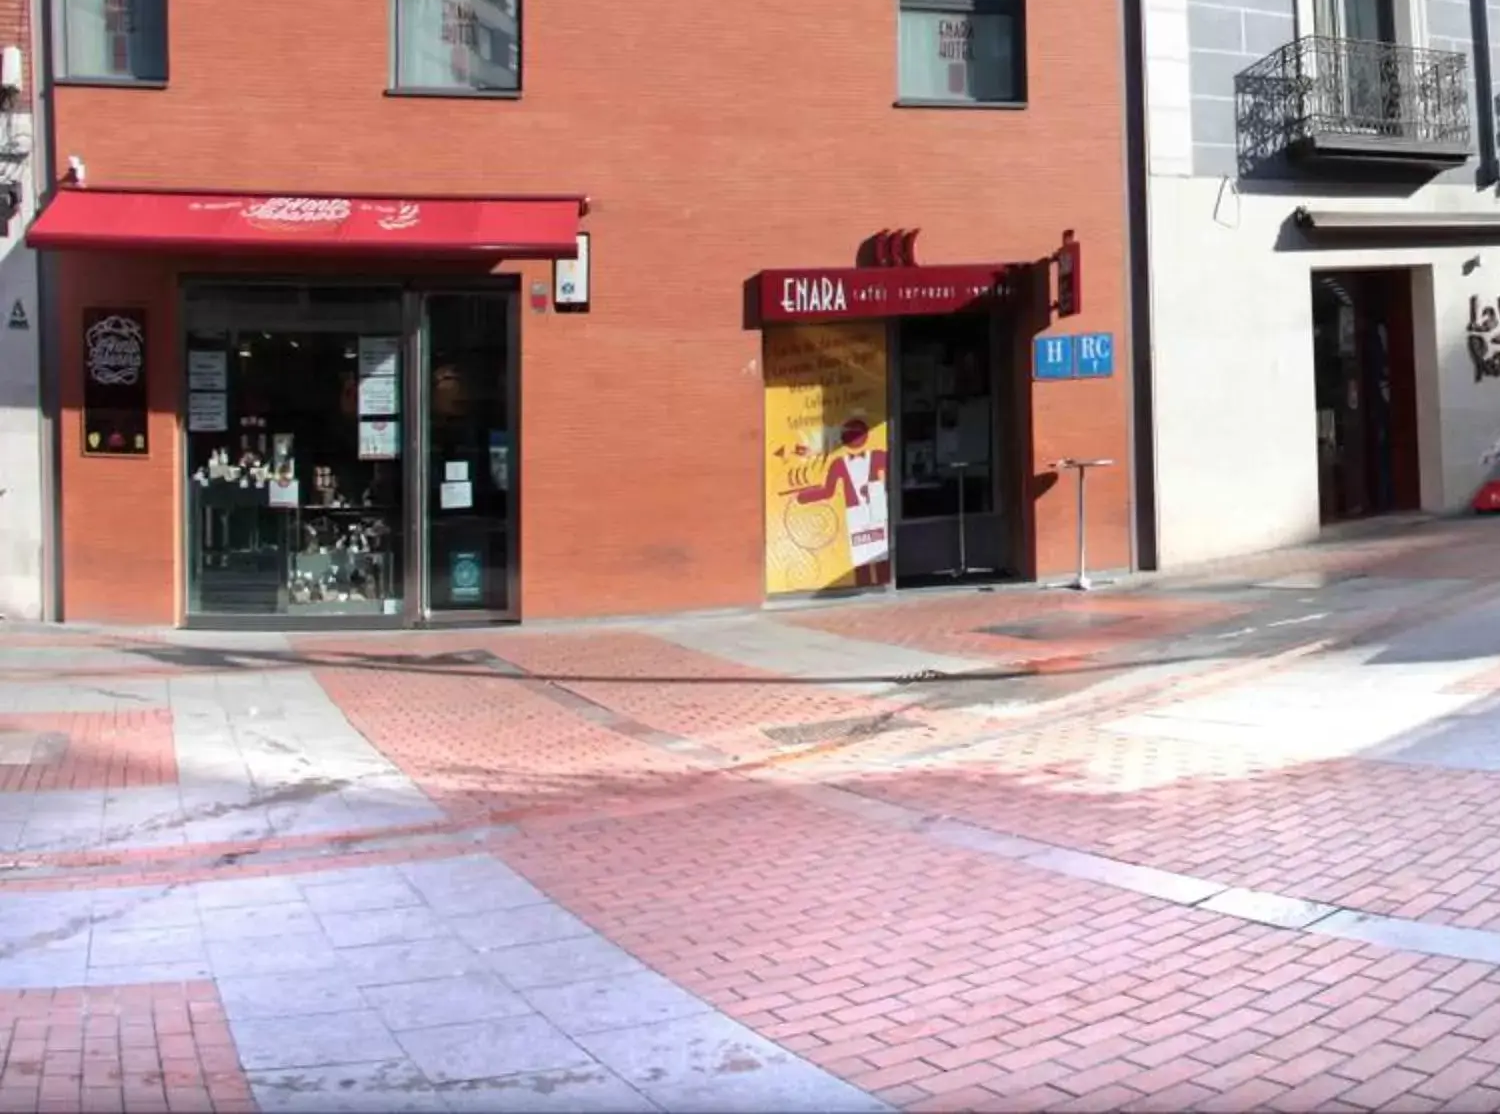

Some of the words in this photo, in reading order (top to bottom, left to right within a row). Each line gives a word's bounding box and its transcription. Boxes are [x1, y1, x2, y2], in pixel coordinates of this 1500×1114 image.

[781, 278, 847, 312] ENARA
[1047, 340, 1063, 363] H
[1081, 336, 1110, 359] RC
